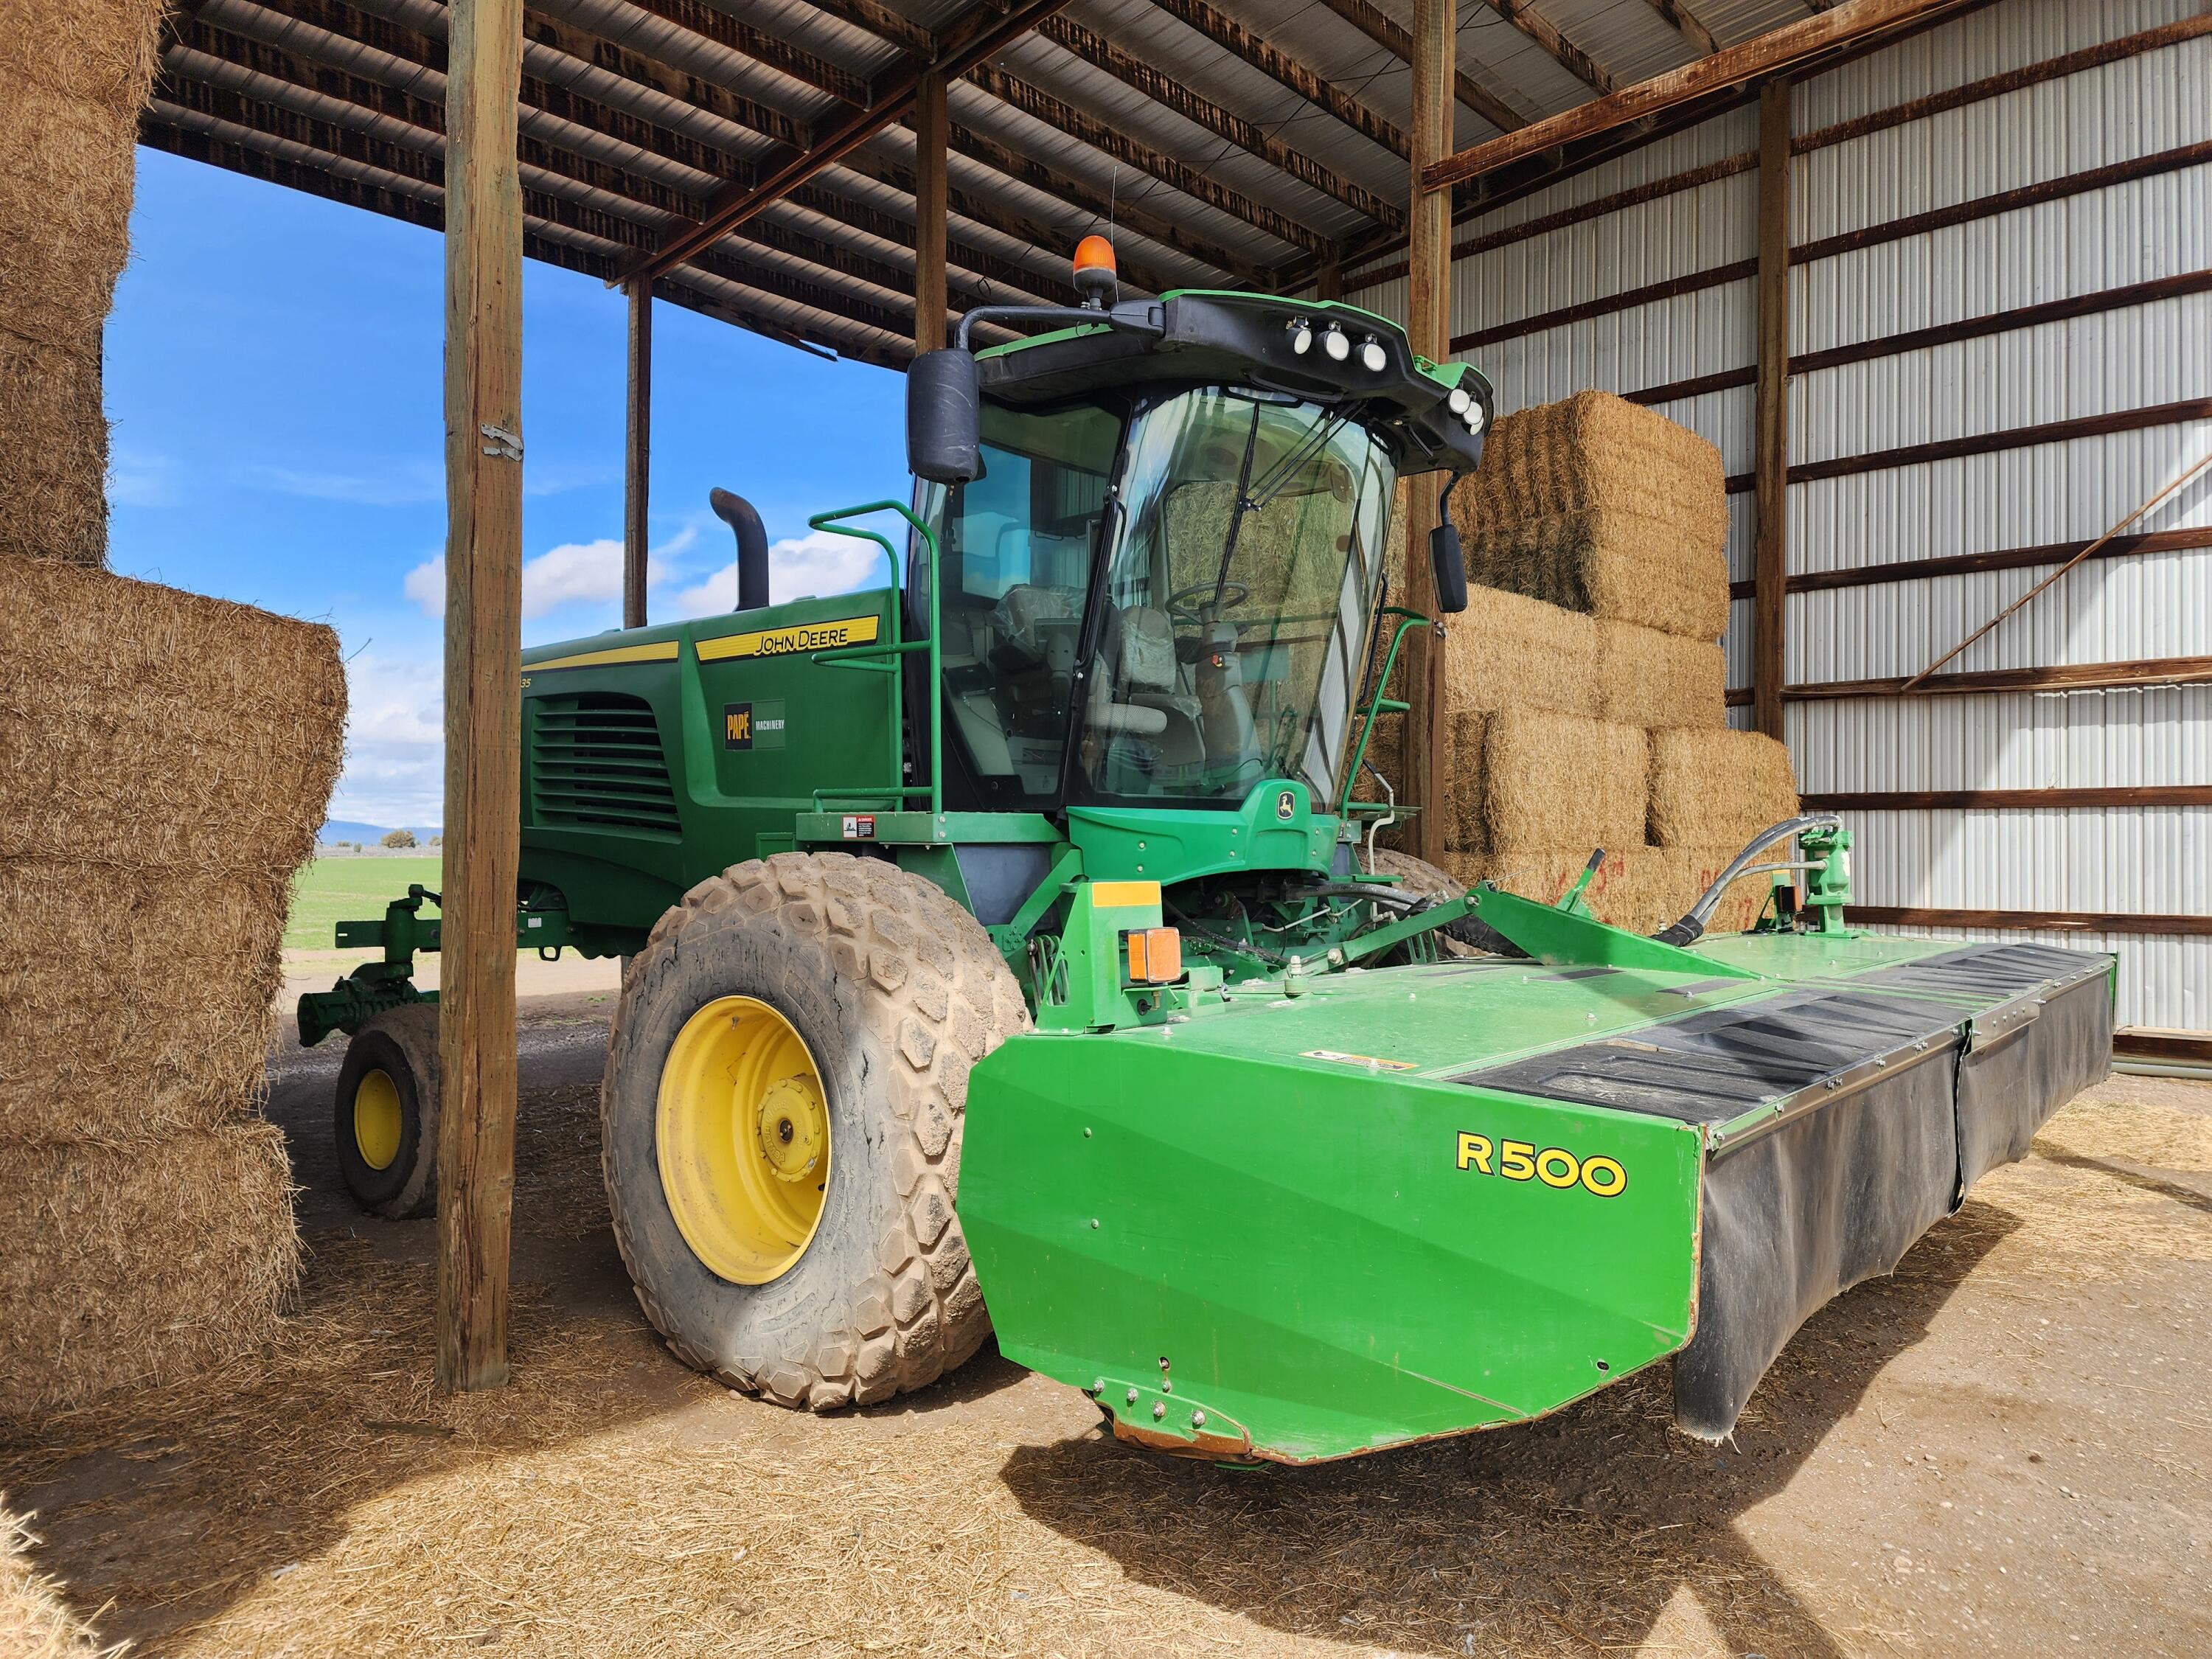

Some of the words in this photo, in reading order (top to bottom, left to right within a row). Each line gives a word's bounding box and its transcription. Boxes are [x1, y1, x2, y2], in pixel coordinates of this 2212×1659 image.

[754, 636, 795, 654] JOHN
[798, 627, 849, 648] DEERE
[755, 719, 785, 731] MACHINERY
